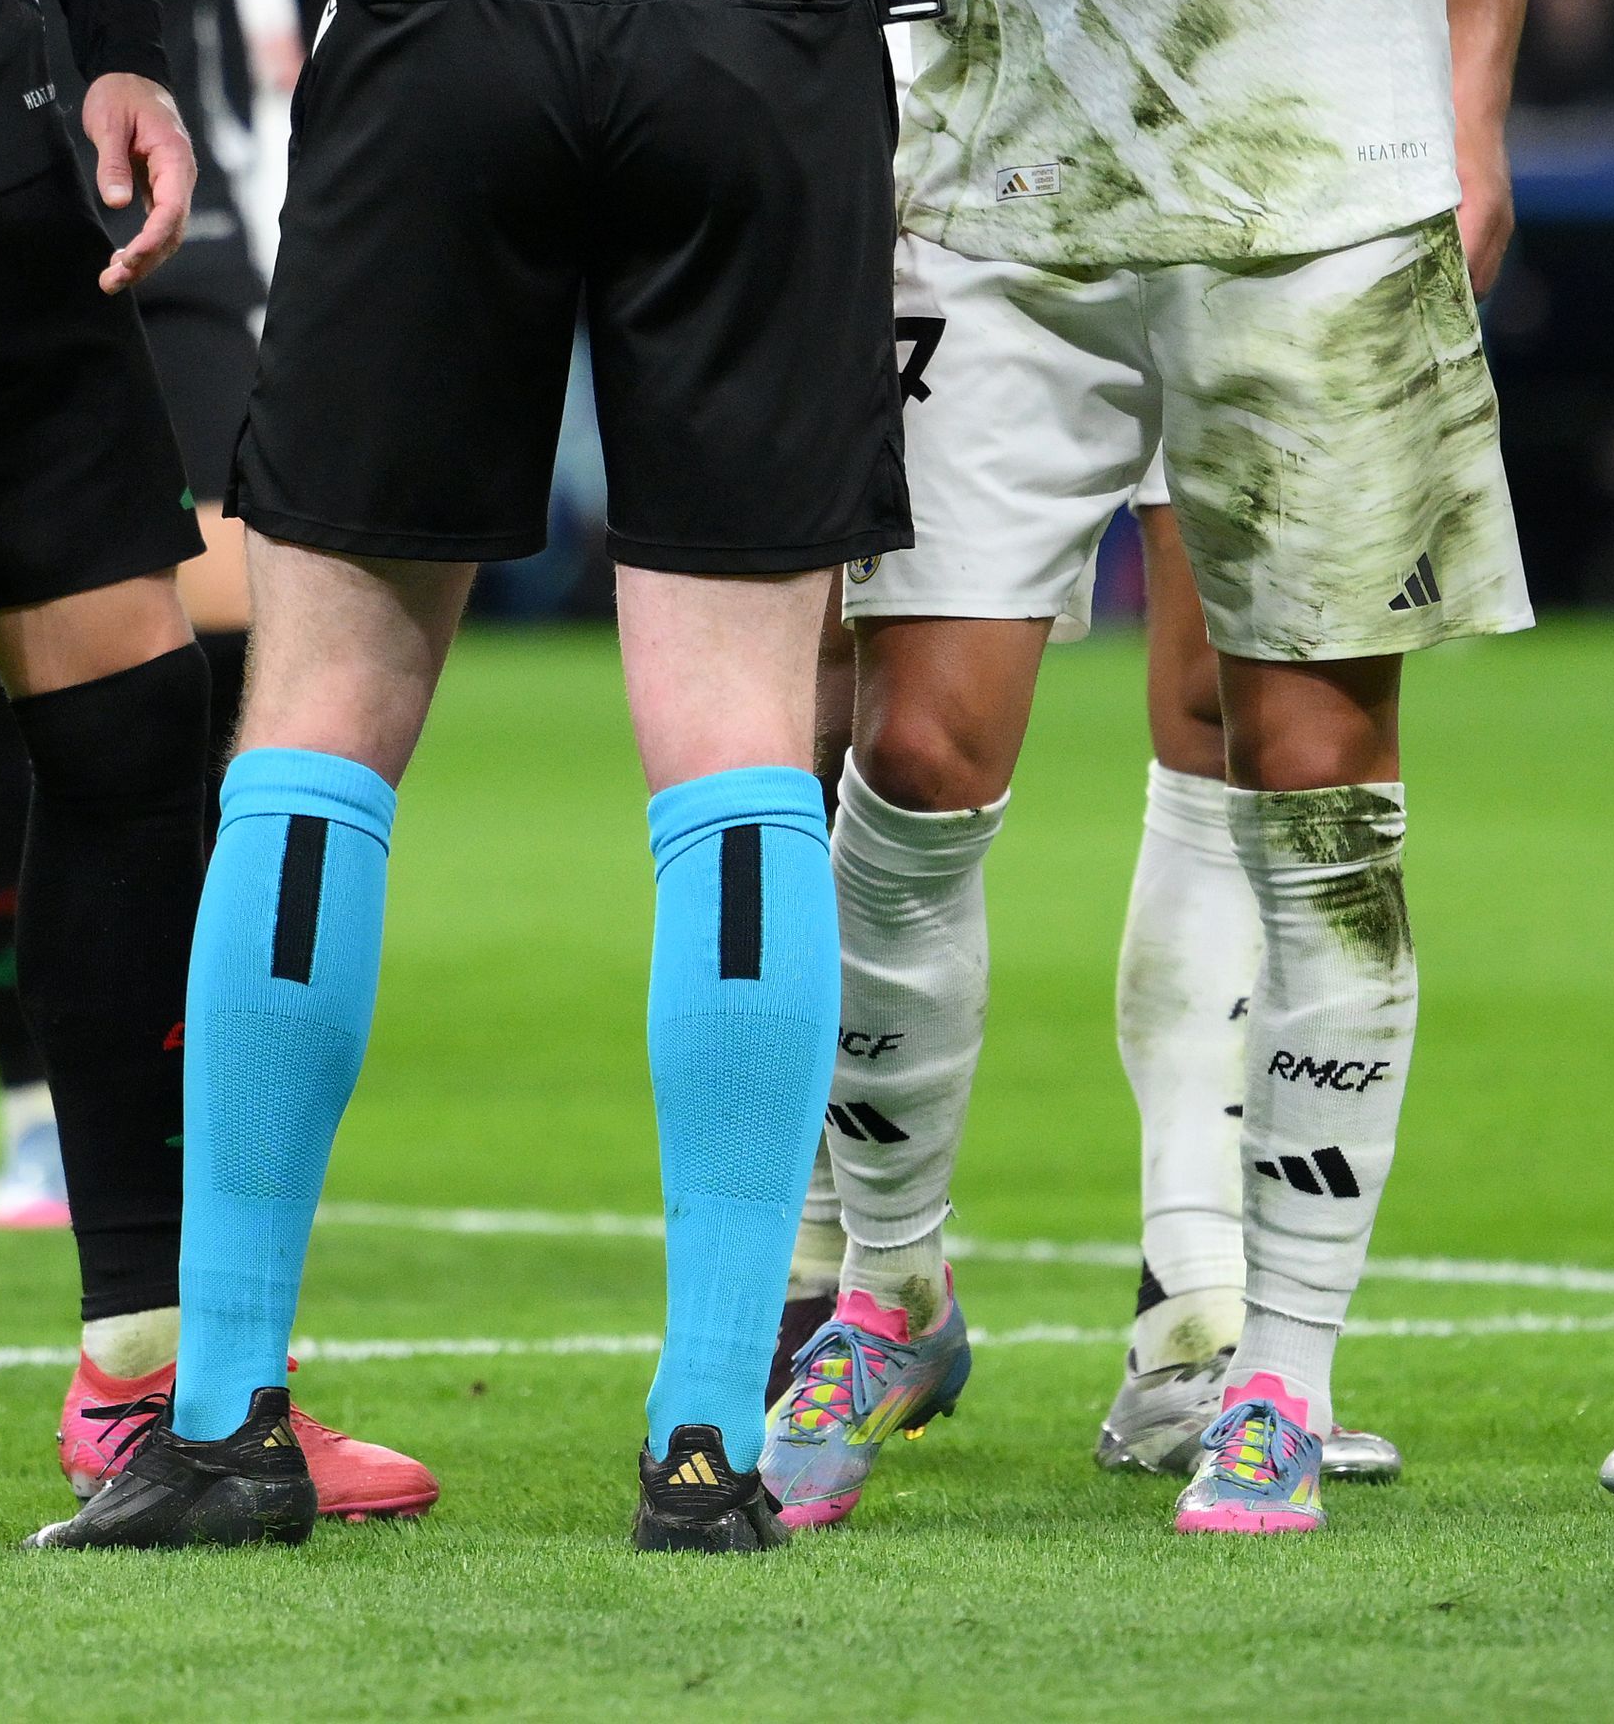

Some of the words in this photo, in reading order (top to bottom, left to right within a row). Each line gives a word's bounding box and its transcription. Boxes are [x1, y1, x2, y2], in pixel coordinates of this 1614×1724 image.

[1357, 141, 1428, 162] HEAT.RDY
[838, 1026, 905, 1060] CF
[1267, 1050, 1391, 1093] RMCF
